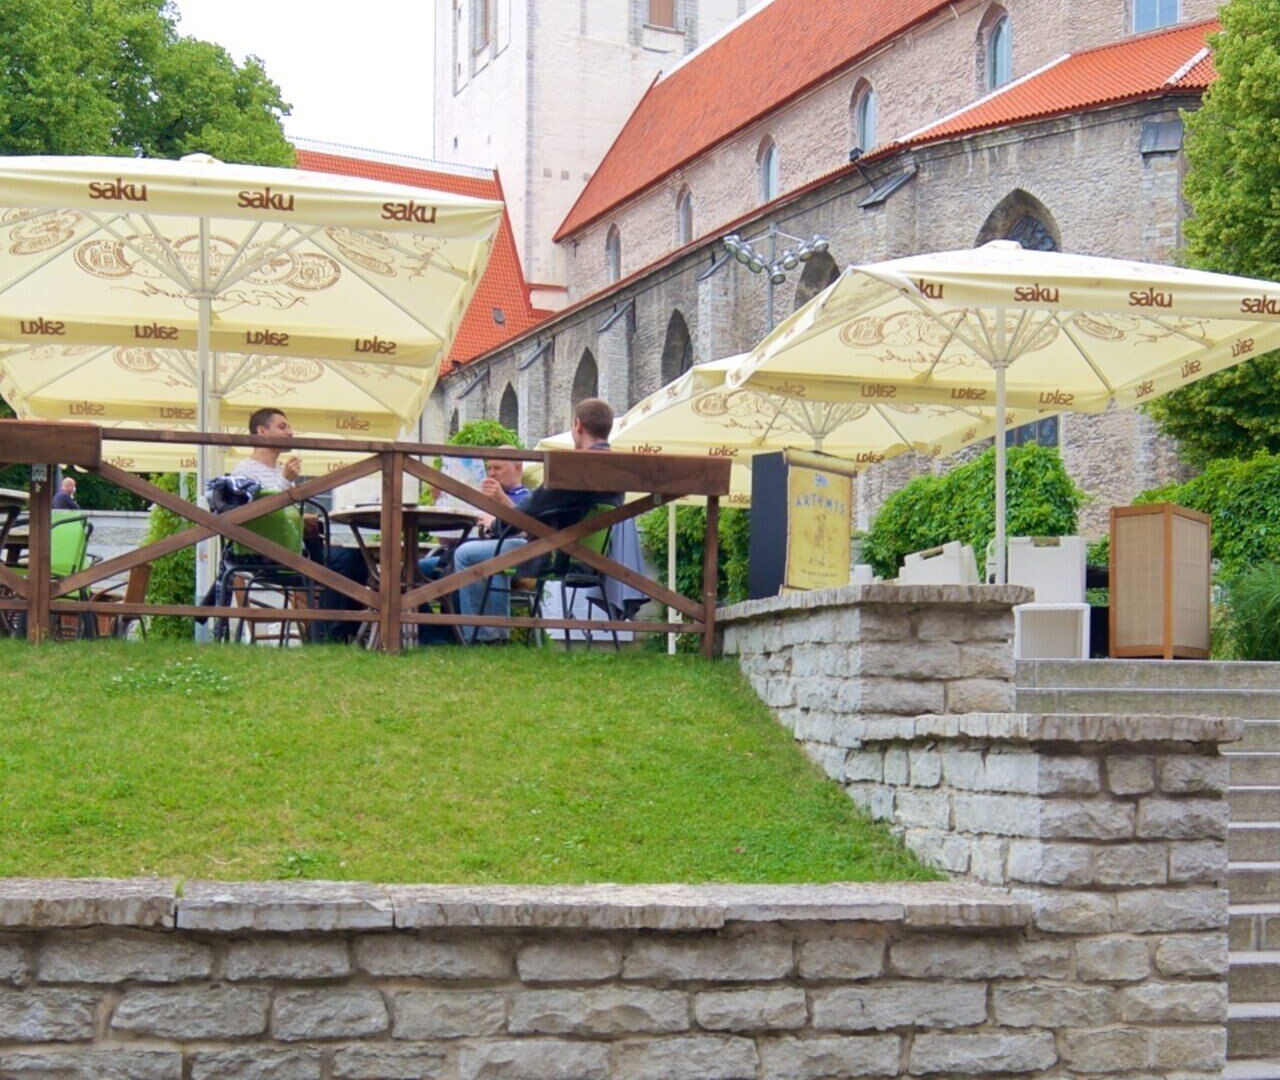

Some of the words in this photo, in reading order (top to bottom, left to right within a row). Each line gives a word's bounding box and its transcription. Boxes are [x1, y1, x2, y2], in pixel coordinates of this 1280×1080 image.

[88, 177, 148, 201] saku
[237, 186, 295, 211] saku
[381, 200, 437, 224] saku
[916, 278, 943, 300] ku
[1014, 283, 1059, 303] saku
[1129, 287, 1173, 308] saku
